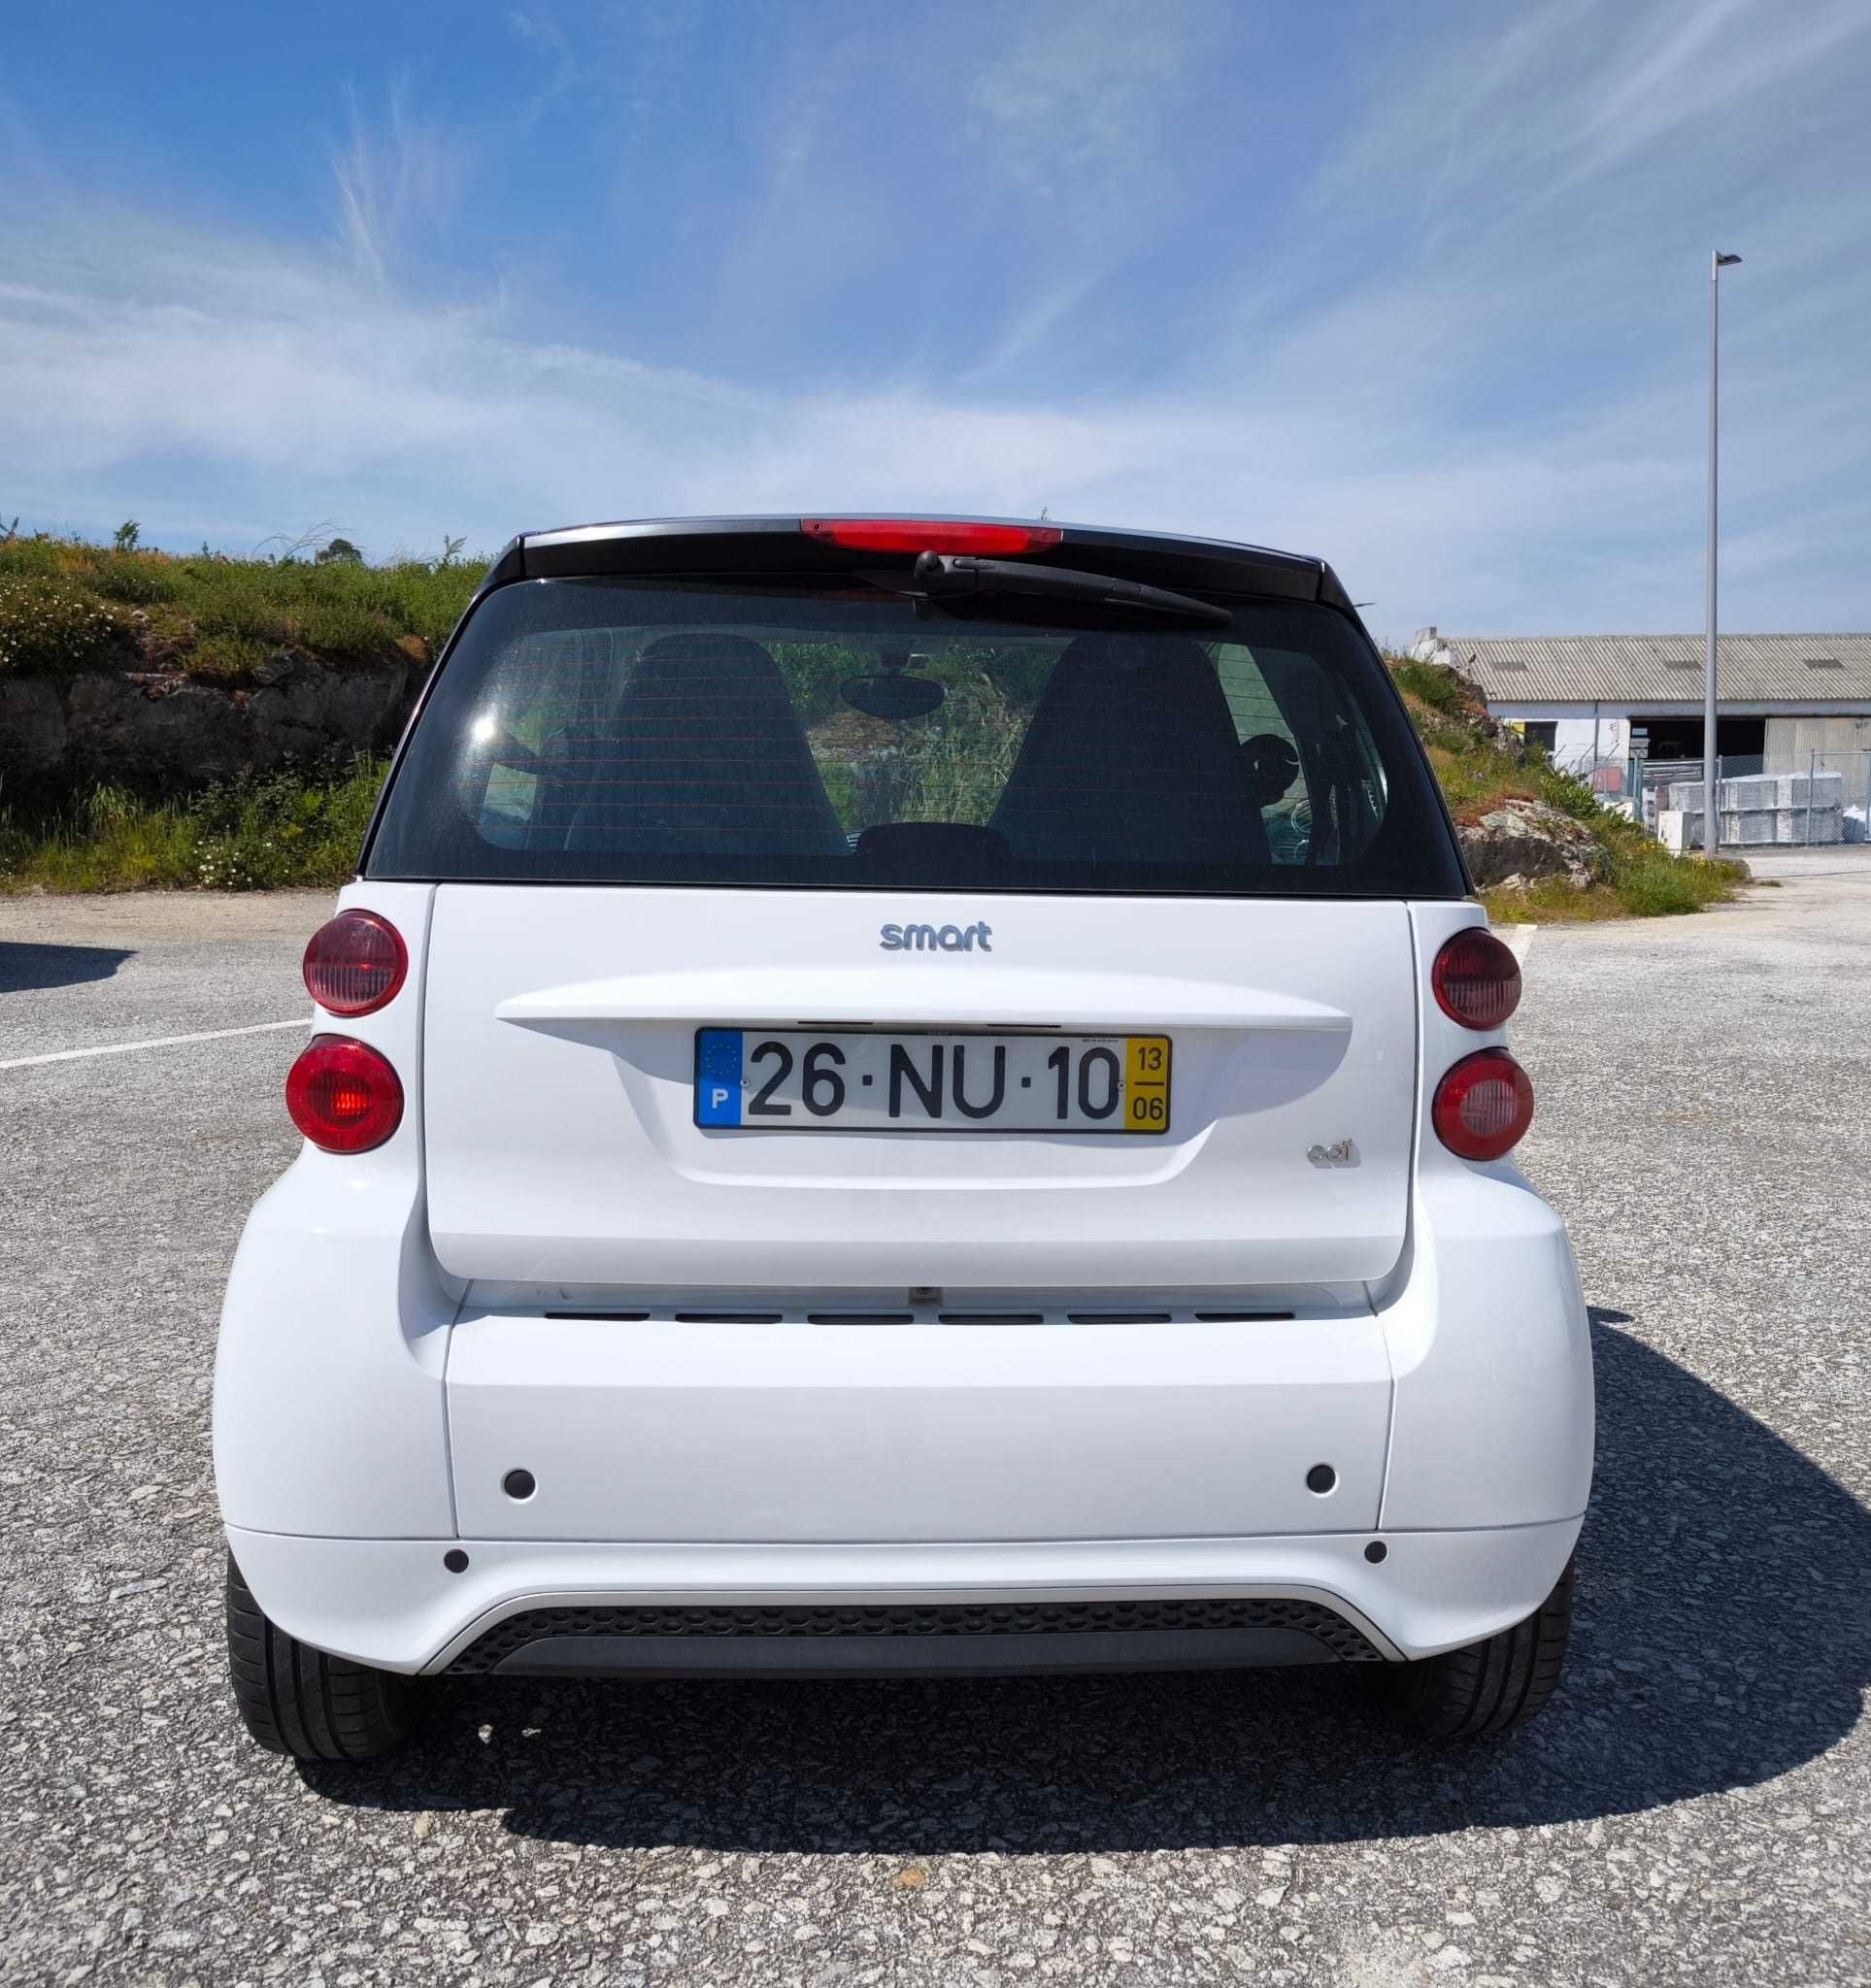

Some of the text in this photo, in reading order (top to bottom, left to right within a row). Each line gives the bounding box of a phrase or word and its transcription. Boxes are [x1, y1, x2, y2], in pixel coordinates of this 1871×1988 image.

[879, 921, 993, 952] smart
[1138, 1046, 1162, 1072] 13
[712, 1088, 729, 1110] P
[1133, 1097, 1164, 1121] 06
